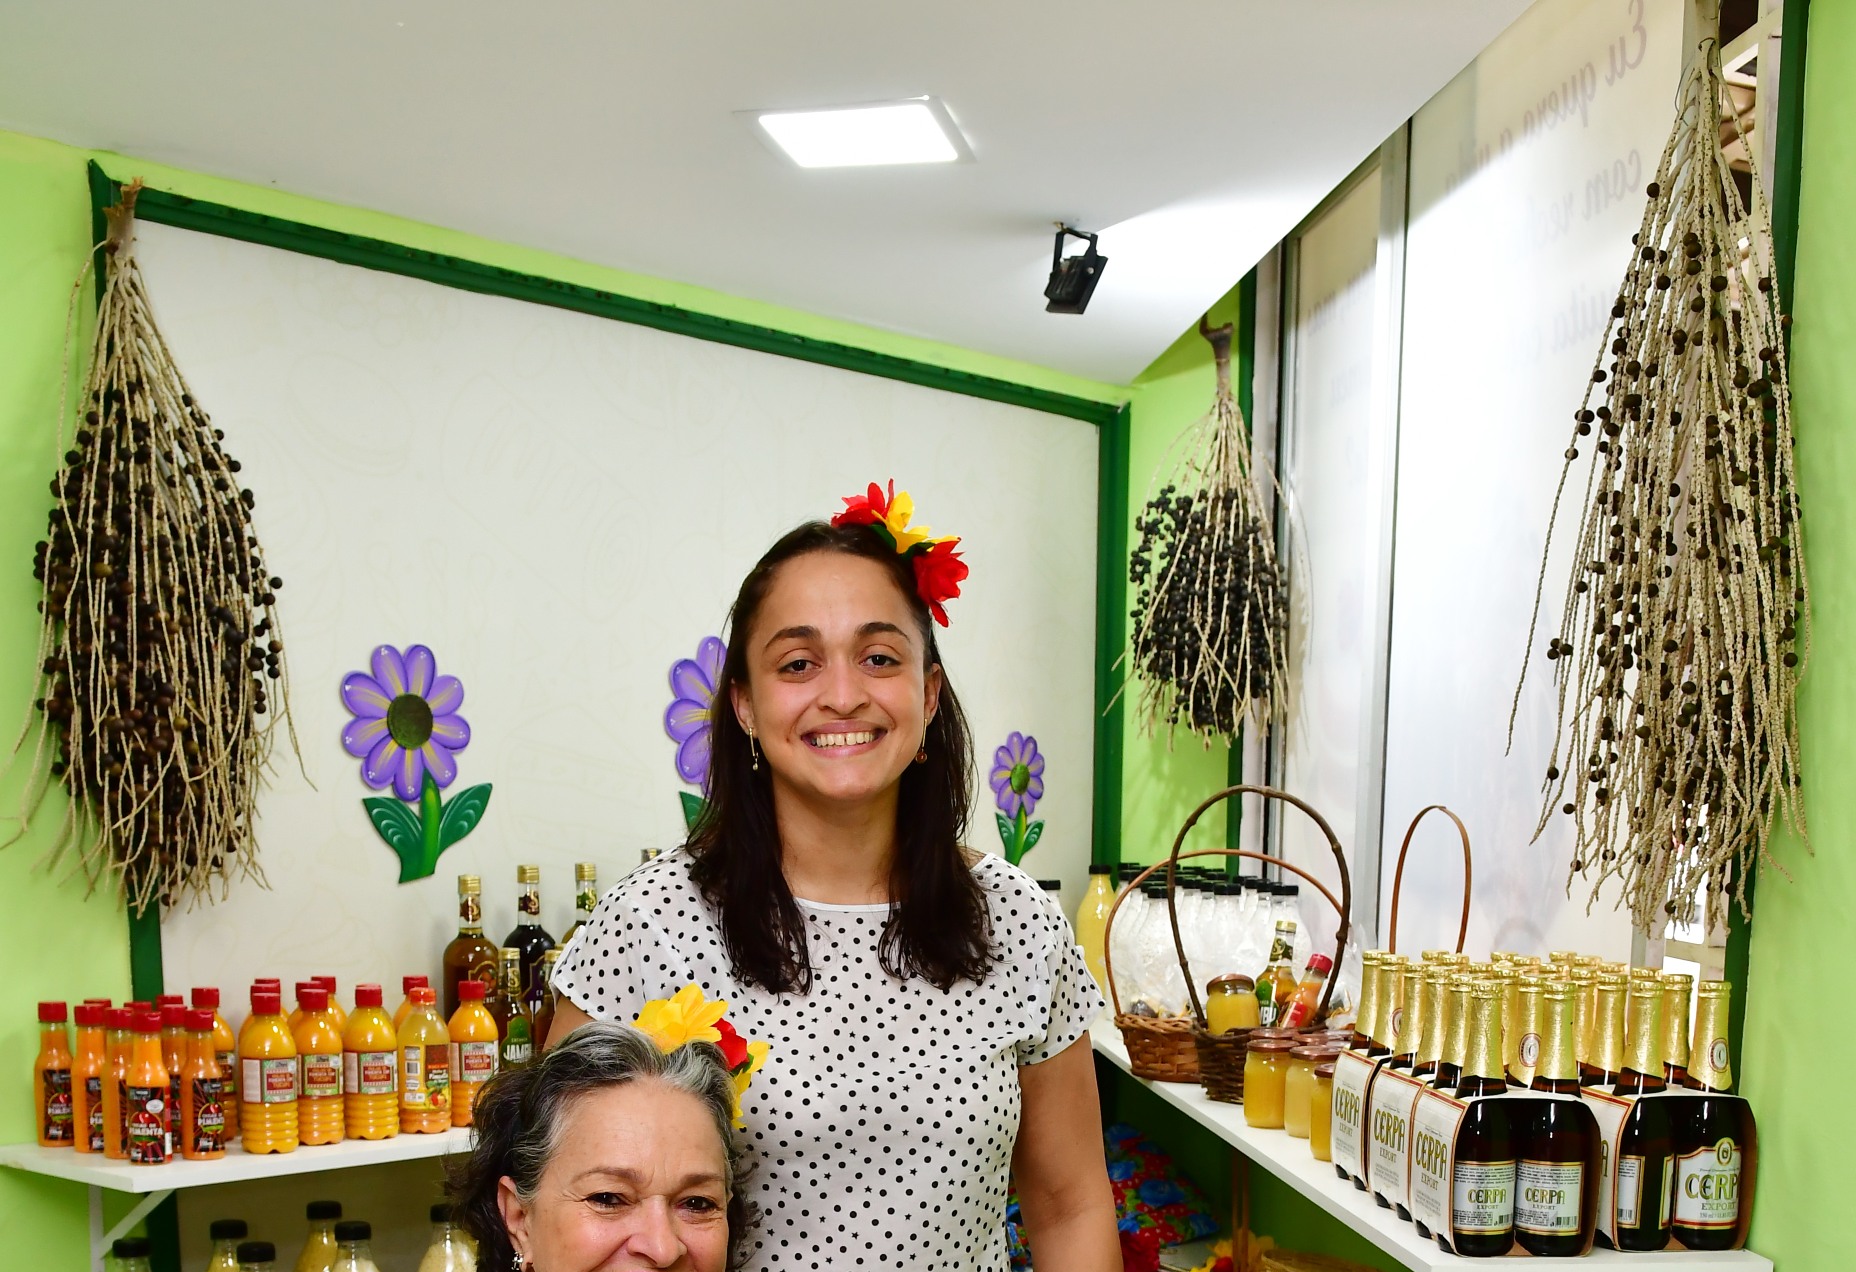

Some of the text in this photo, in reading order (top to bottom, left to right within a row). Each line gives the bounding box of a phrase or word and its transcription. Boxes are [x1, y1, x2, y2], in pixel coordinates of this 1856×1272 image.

[1333, 1086, 1360, 1128] CERPA
[1373, 1108, 1406, 1154] CERPA
[1380, 1146, 1397, 1164] EXPORT
[1415, 1131, 1448, 1182] CERPA
[1420, 1171, 1439, 1191] EXPORT
[1684, 1173, 1739, 1200] CERP
[1467, 1188, 1507, 1204] CERPA
[1525, 1187, 1566, 1205] CERPA
[1701, 1201, 1736, 1211] EXPORT
